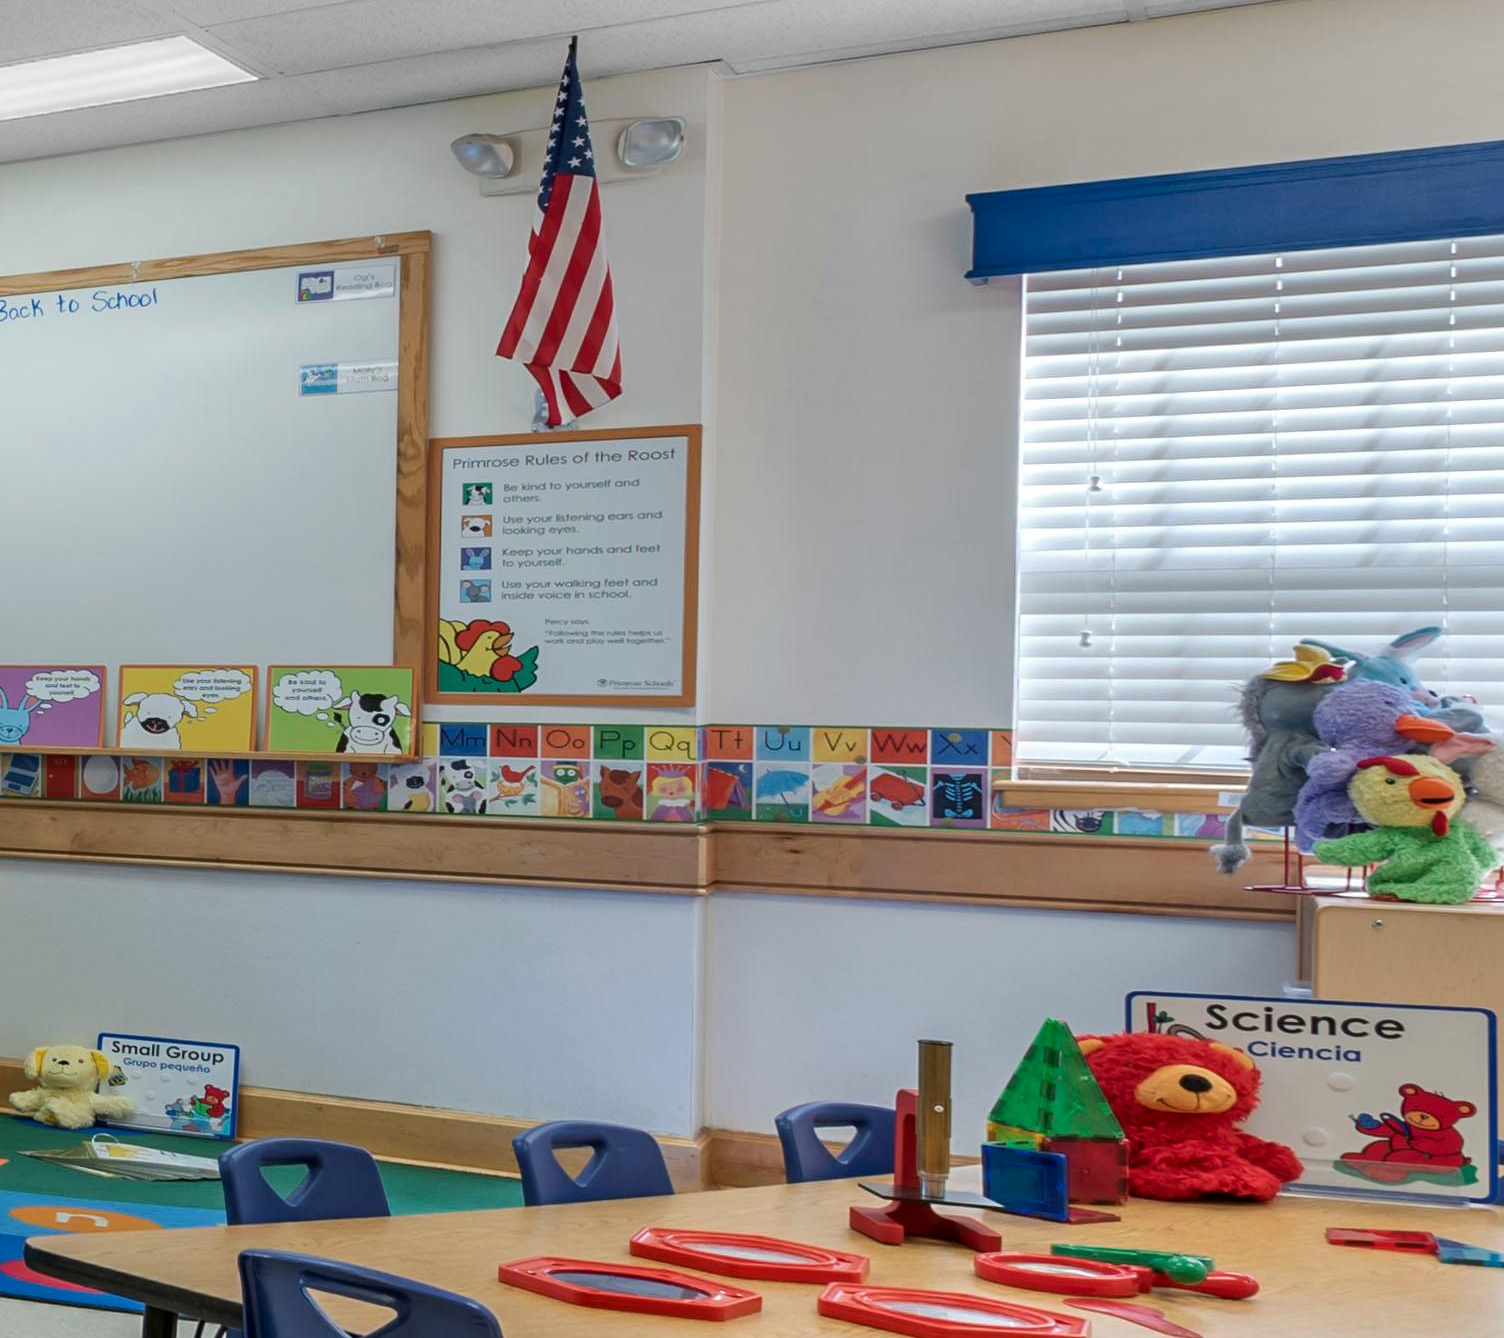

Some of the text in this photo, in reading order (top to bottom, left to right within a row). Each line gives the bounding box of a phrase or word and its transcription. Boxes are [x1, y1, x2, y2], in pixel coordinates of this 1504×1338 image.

[59, 293, 80, 314] to
[92, 288, 159, 312] School
[452, 448, 676, 469] Primrose Rules of the Roost
[503, 478, 640, 492] Be kind to yourself and
[503, 511, 663, 525] Use your listening ears and
[502, 526, 545, 536] looking
[502, 545, 661, 558] Keep your hands and feet
[502, 559, 514, 567] to
[501, 578, 658, 590] Use your walking feet and
[501, 591, 534, 600] inside
[538, 591, 571, 600] voice
[574, 590, 585, 599] in
[442, 730, 486, 748] Mm
[495, 729, 532, 749] Nn
[546, 730, 585, 750] Oo
[600, 730, 637, 757] Pp
[711, 730, 744, 750] Tt
[825, 732, 857, 753] Vv
[873, 732, 926, 755] Ww
[1205, 1003, 1406, 1041] Science
[111, 1040, 224, 1066] Small Group
[1247, 1039, 1361, 1063] Ciencia
[123, 1057, 211, 1075] Grupo pequeño
